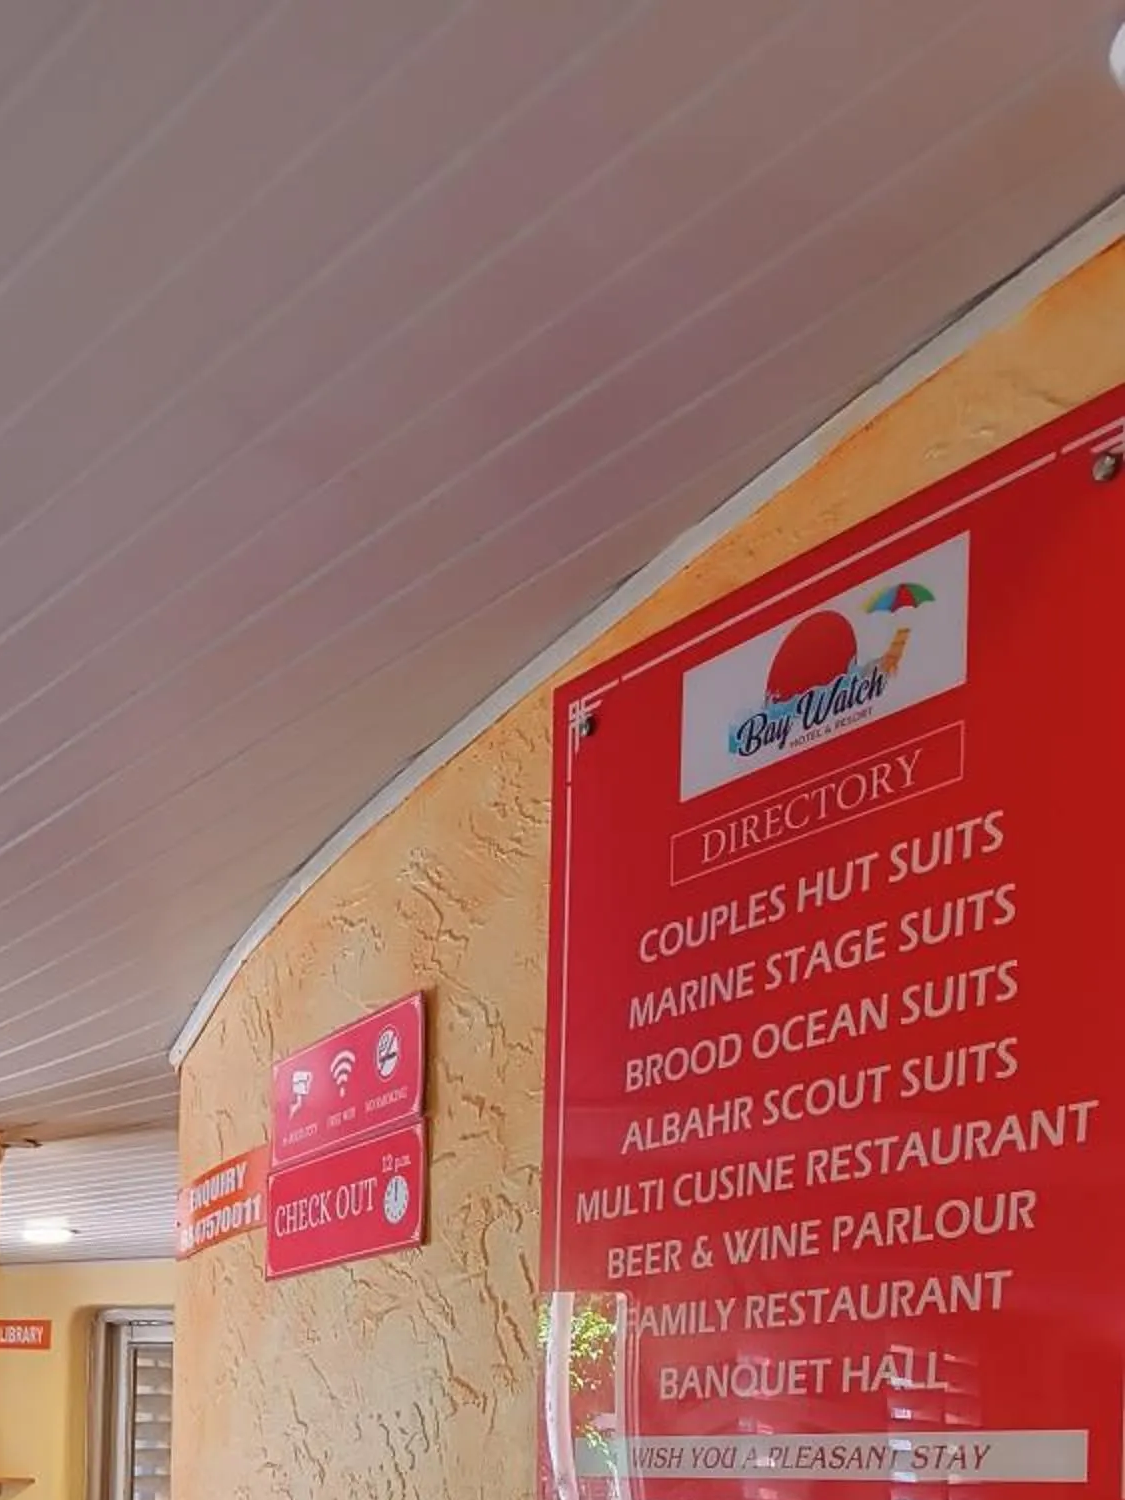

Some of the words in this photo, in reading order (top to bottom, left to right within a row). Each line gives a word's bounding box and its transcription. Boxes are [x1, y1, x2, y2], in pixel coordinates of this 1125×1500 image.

[736, 712, 792, 756] Bay
[796, 666, 888, 730] Watch
[789, 731, 822, 748] HOTEL
[834, 706, 874, 730] RESORT
[700, 749, 924, 865] DIRECTORY
[639, 887, 786, 964] COUPLES
[797, 853, 878, 913] HUT
[888, 810, 1005, 884] SUITS
[629, 961, 755, 1030] MARINE
[765, 922, 887, 992] STAGE
[899, 883, 1017, 954] SUITS
[625, 1032, 741, 1092] BROOD
[752, 993, 888, 1059] OCEAN
[901, 960, 1019, 1026] SUITS
[621, 1096, 752, 1154] ALBAHR
[763, 1064, 892, 1126] SCOUT
[901, 1037, 1019, 1098] SUITS
[382, 1154, 394, 1174] 12
[577, 1178, 664, 1224] MULTI
[673, 1155, 794, 1208] CUSINE
[806, 1100, 1100, 1186] RESTAURANT
[275, 1189, 333, 1238] CHECK
[336, 1177, 377, 1221] OUT
[607, 1238, 681, 1279] BEER
[691, 1236, 714, 1270] &
[726, 1219, 821, 1266] WINE
[832, 1189, 1036, 1252] PARLOUR
[745, 1271, 1013, 1329] RESTAURANT
[660, 1358, 832, 1400] BANQUET
[841, 1350, 949, 1392] HALL
[632, 1446, 683, 1470] WISH
[691, 1446, 738, 1470] YOU
[768, 1445, 899, 1470] PLEASANT
[910, 1444, 991, 1471] STAY
